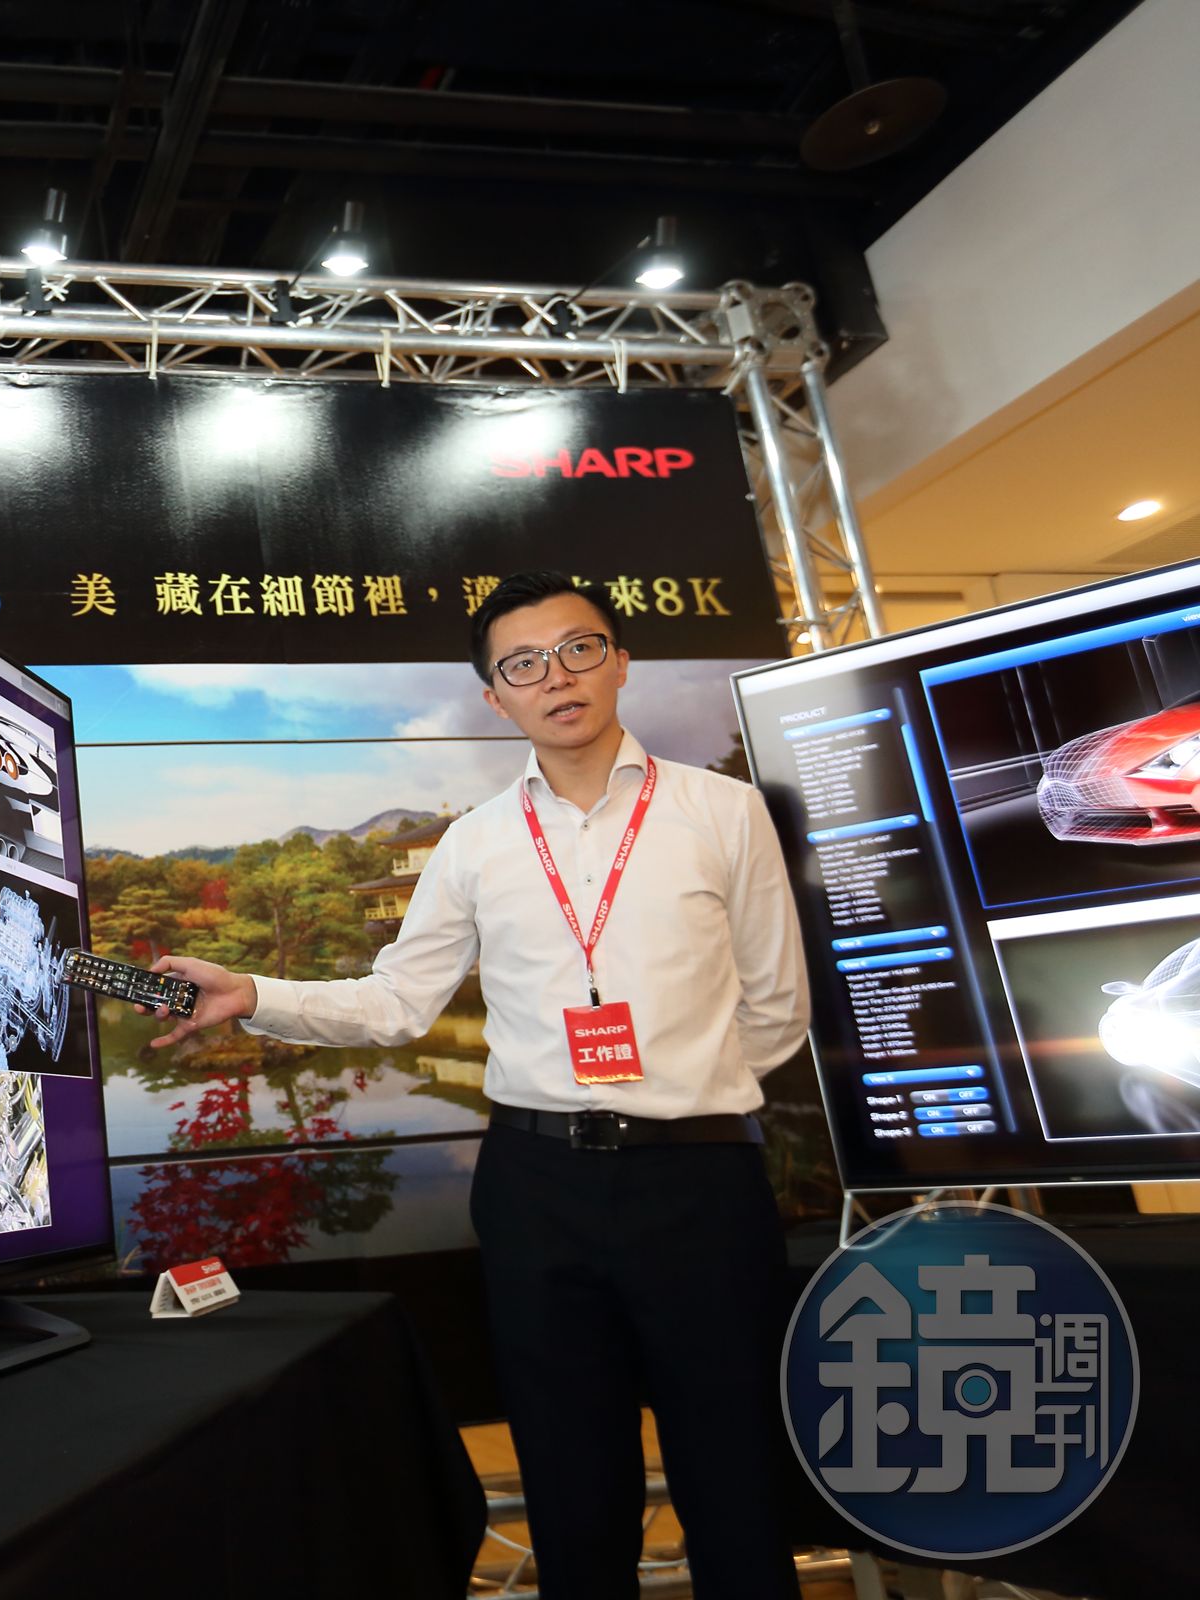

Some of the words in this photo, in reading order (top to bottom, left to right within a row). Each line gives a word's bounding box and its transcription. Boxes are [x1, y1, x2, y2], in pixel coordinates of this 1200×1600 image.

[490, 446, 694, 478] SHARP
[71, 572, 117, 617] 美
[641, 764, 656, 802] SHARP
[535, 836, 556, 877] SHARP
[614, 827, 635, 871] SHARP
[588, 900, 609, 945] SHARP
[574, 1024, 628, 1038] SHARP
[577, 1043, 634, 1064] 工作證
